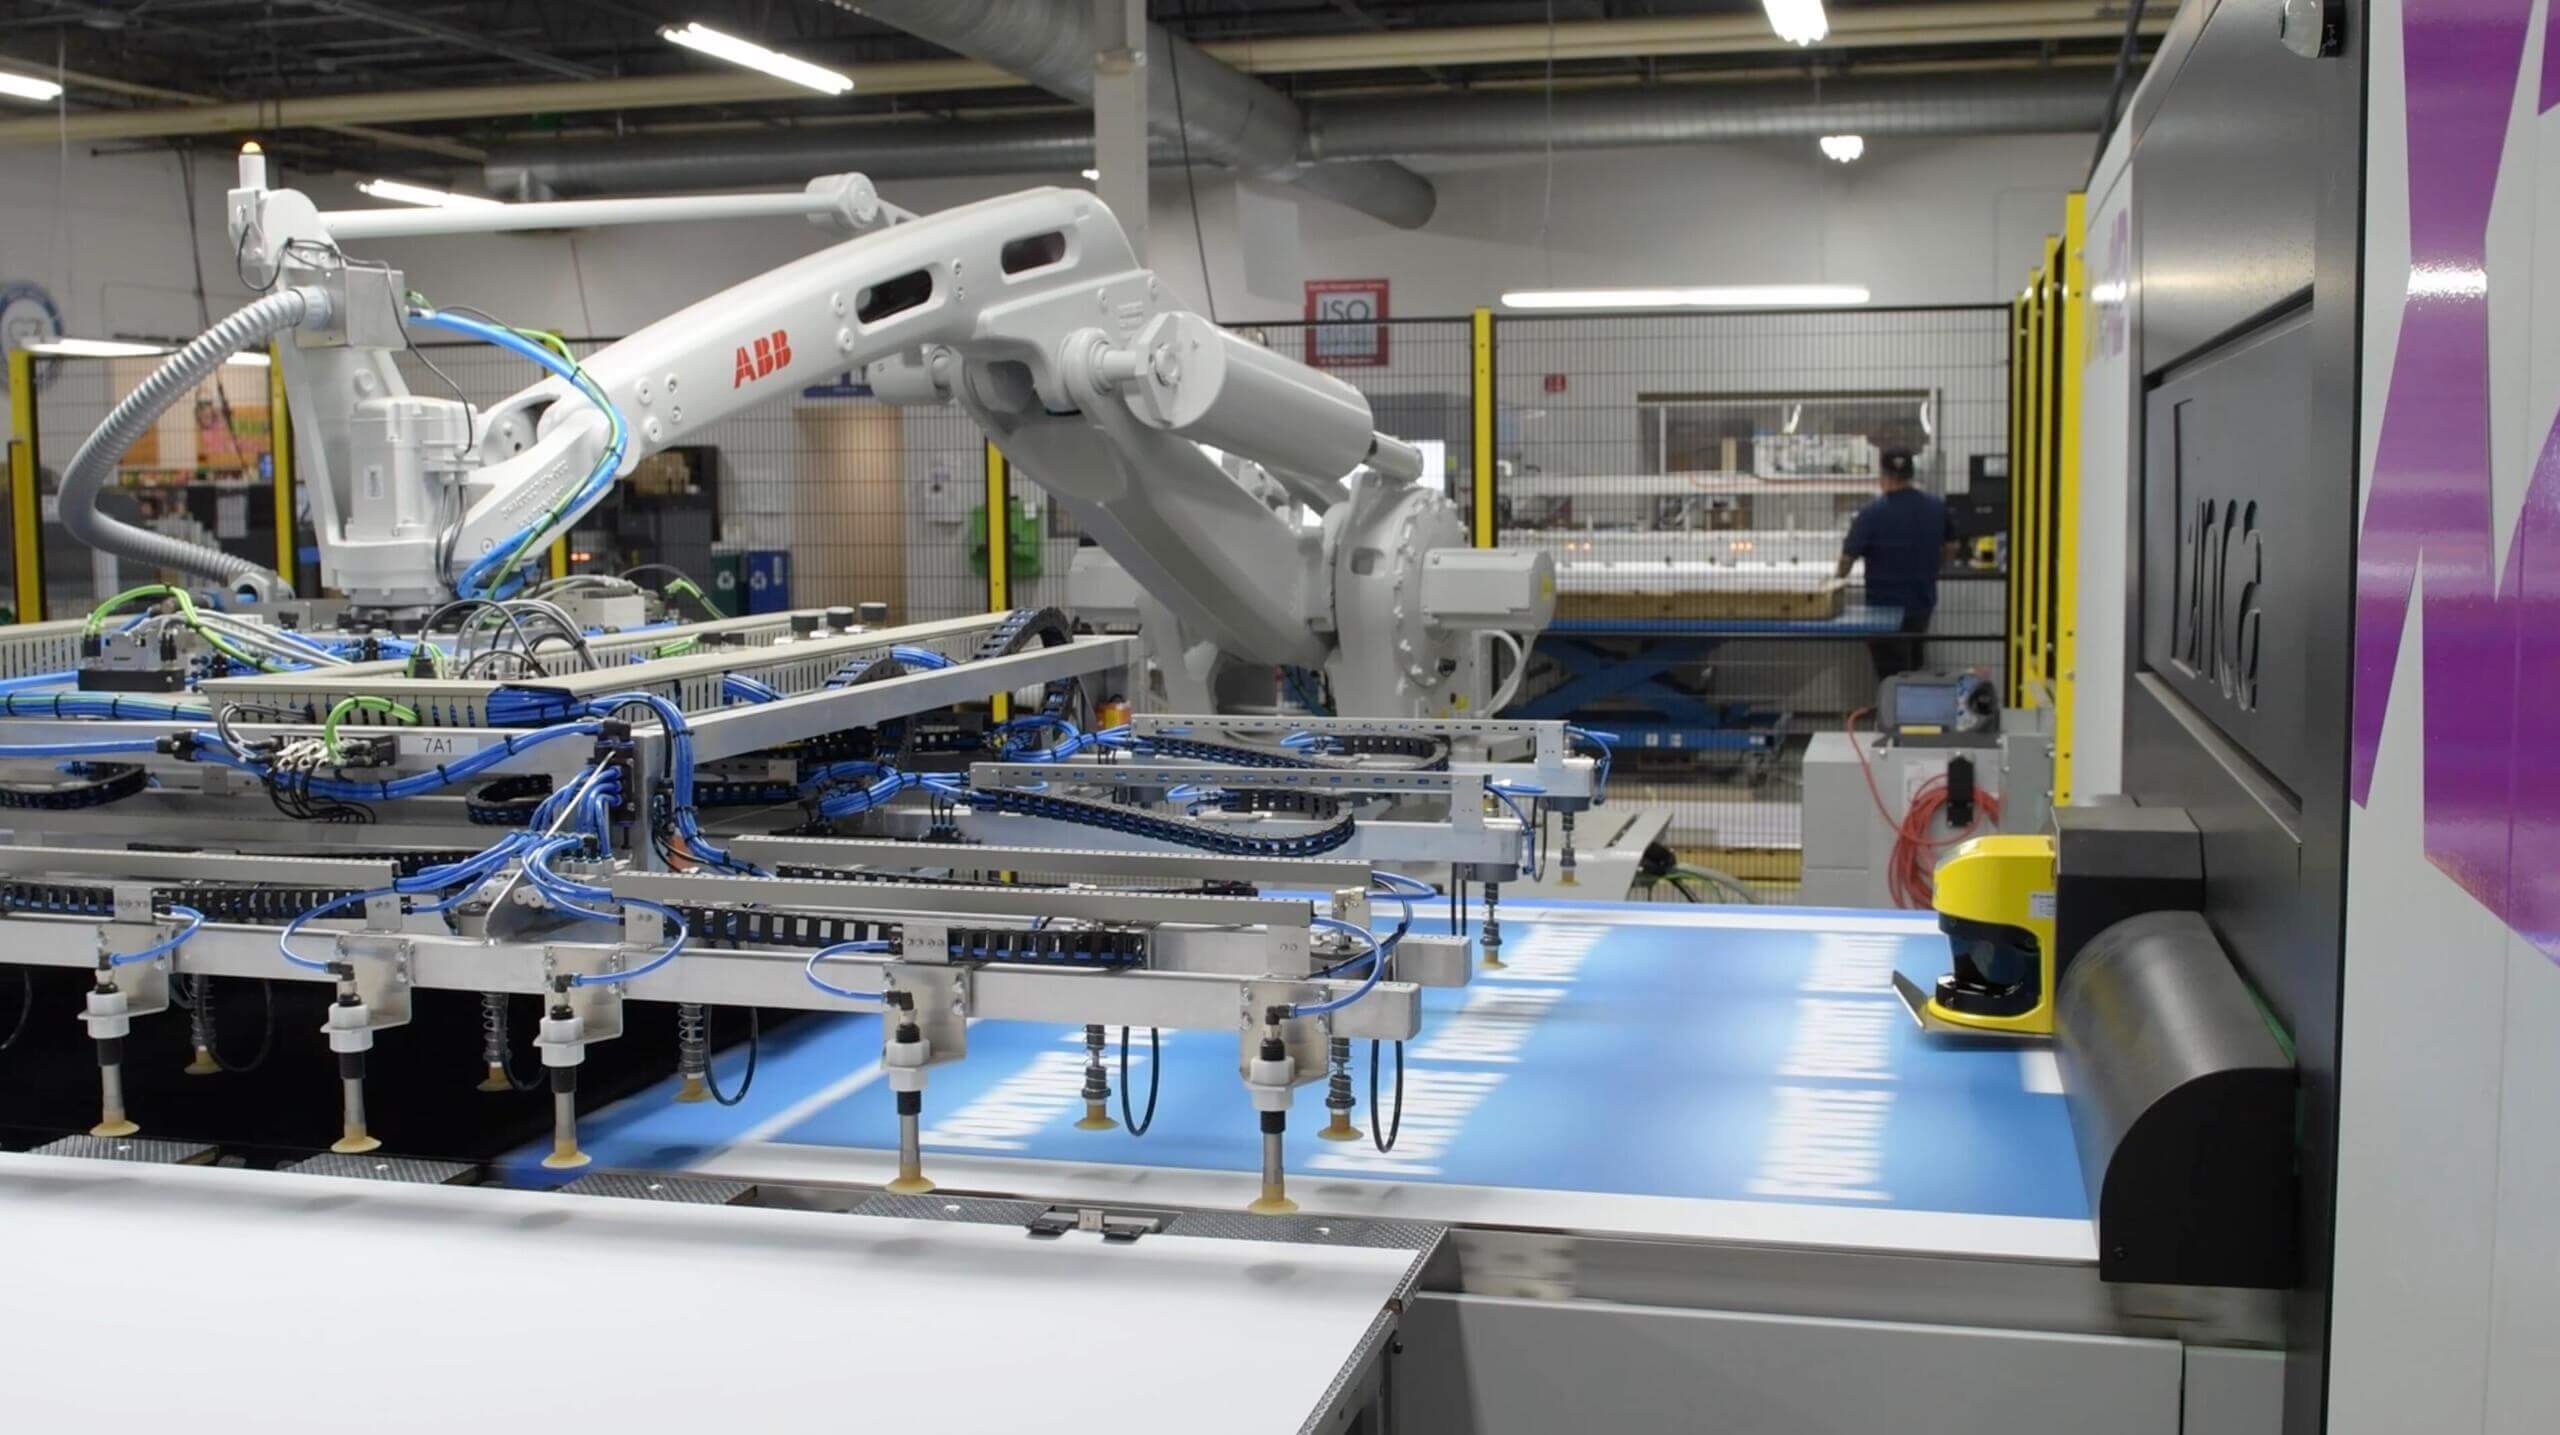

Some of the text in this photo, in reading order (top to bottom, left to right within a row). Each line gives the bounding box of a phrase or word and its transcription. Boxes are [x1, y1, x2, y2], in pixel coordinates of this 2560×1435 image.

[1322, 299, 1370, 322] ISO
[734, 329, 792, 390] ABB
[423, 737, 452, 753] 7A1
